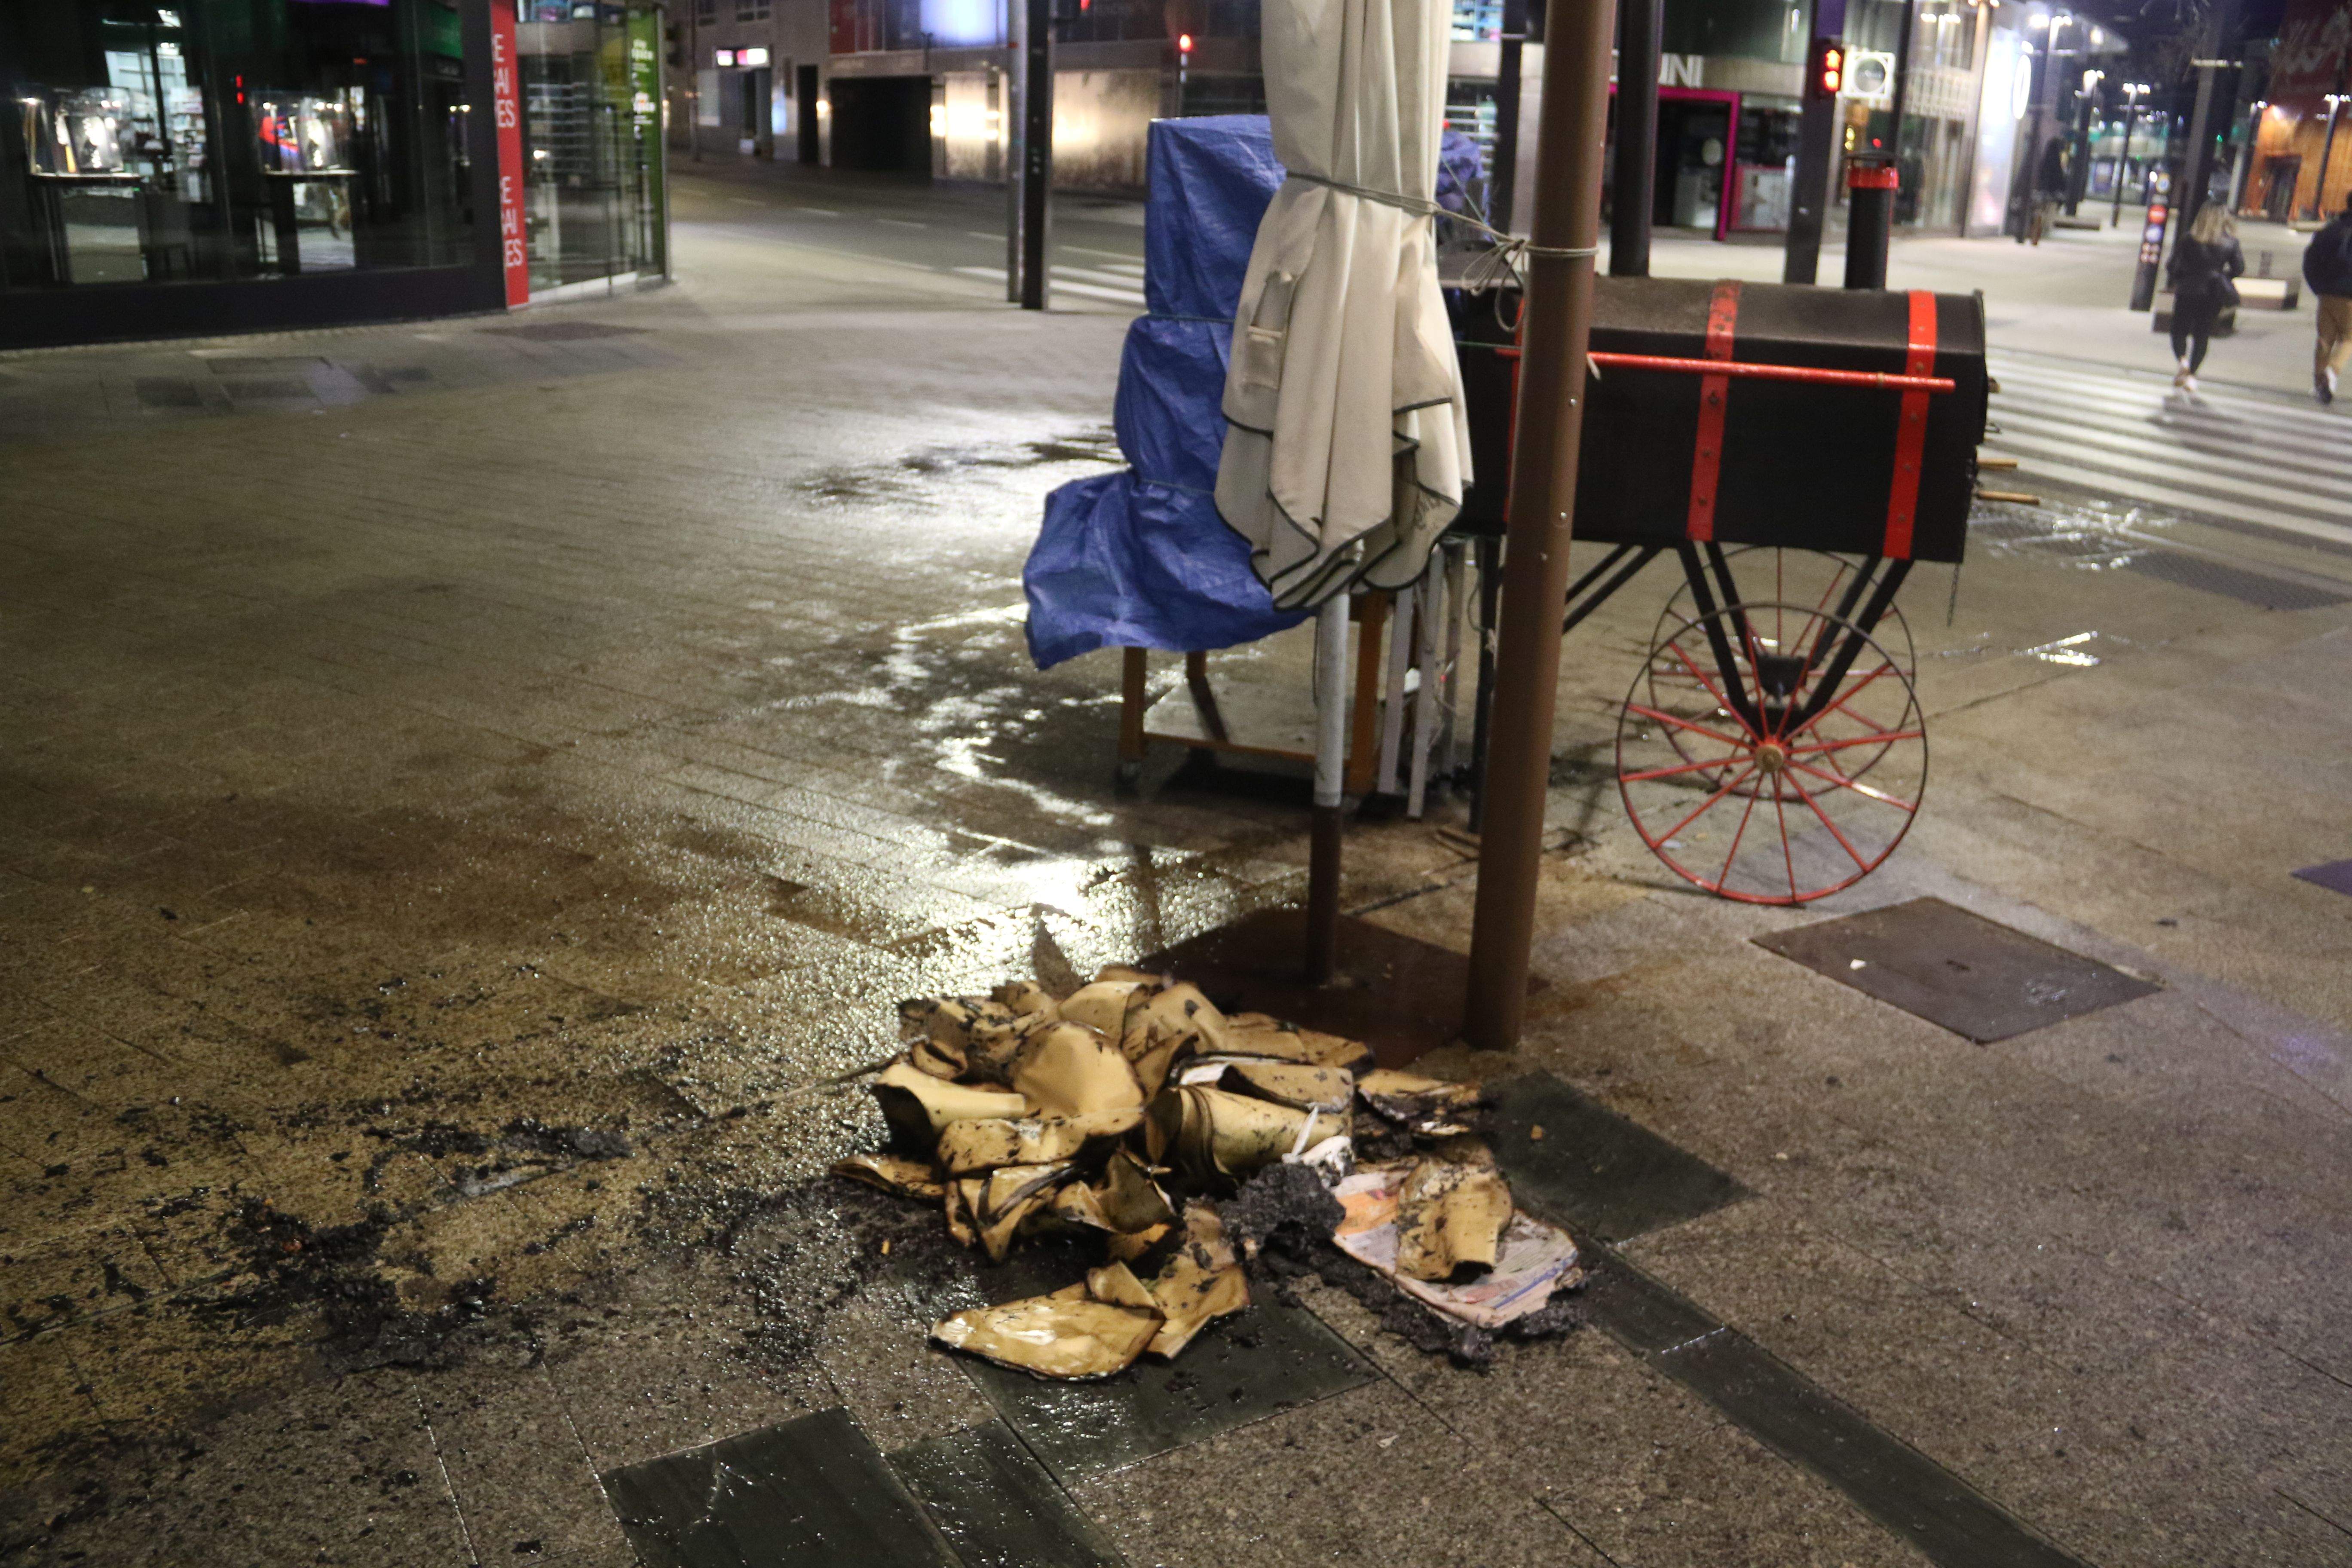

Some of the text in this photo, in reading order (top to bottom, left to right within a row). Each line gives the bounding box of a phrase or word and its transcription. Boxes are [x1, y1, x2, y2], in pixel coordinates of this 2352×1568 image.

[492, 33, 505, 62] E
[496, 99, 516, 128] ES
[500, 175, 513, 204] E
[505, 238, 523, 268] ES
